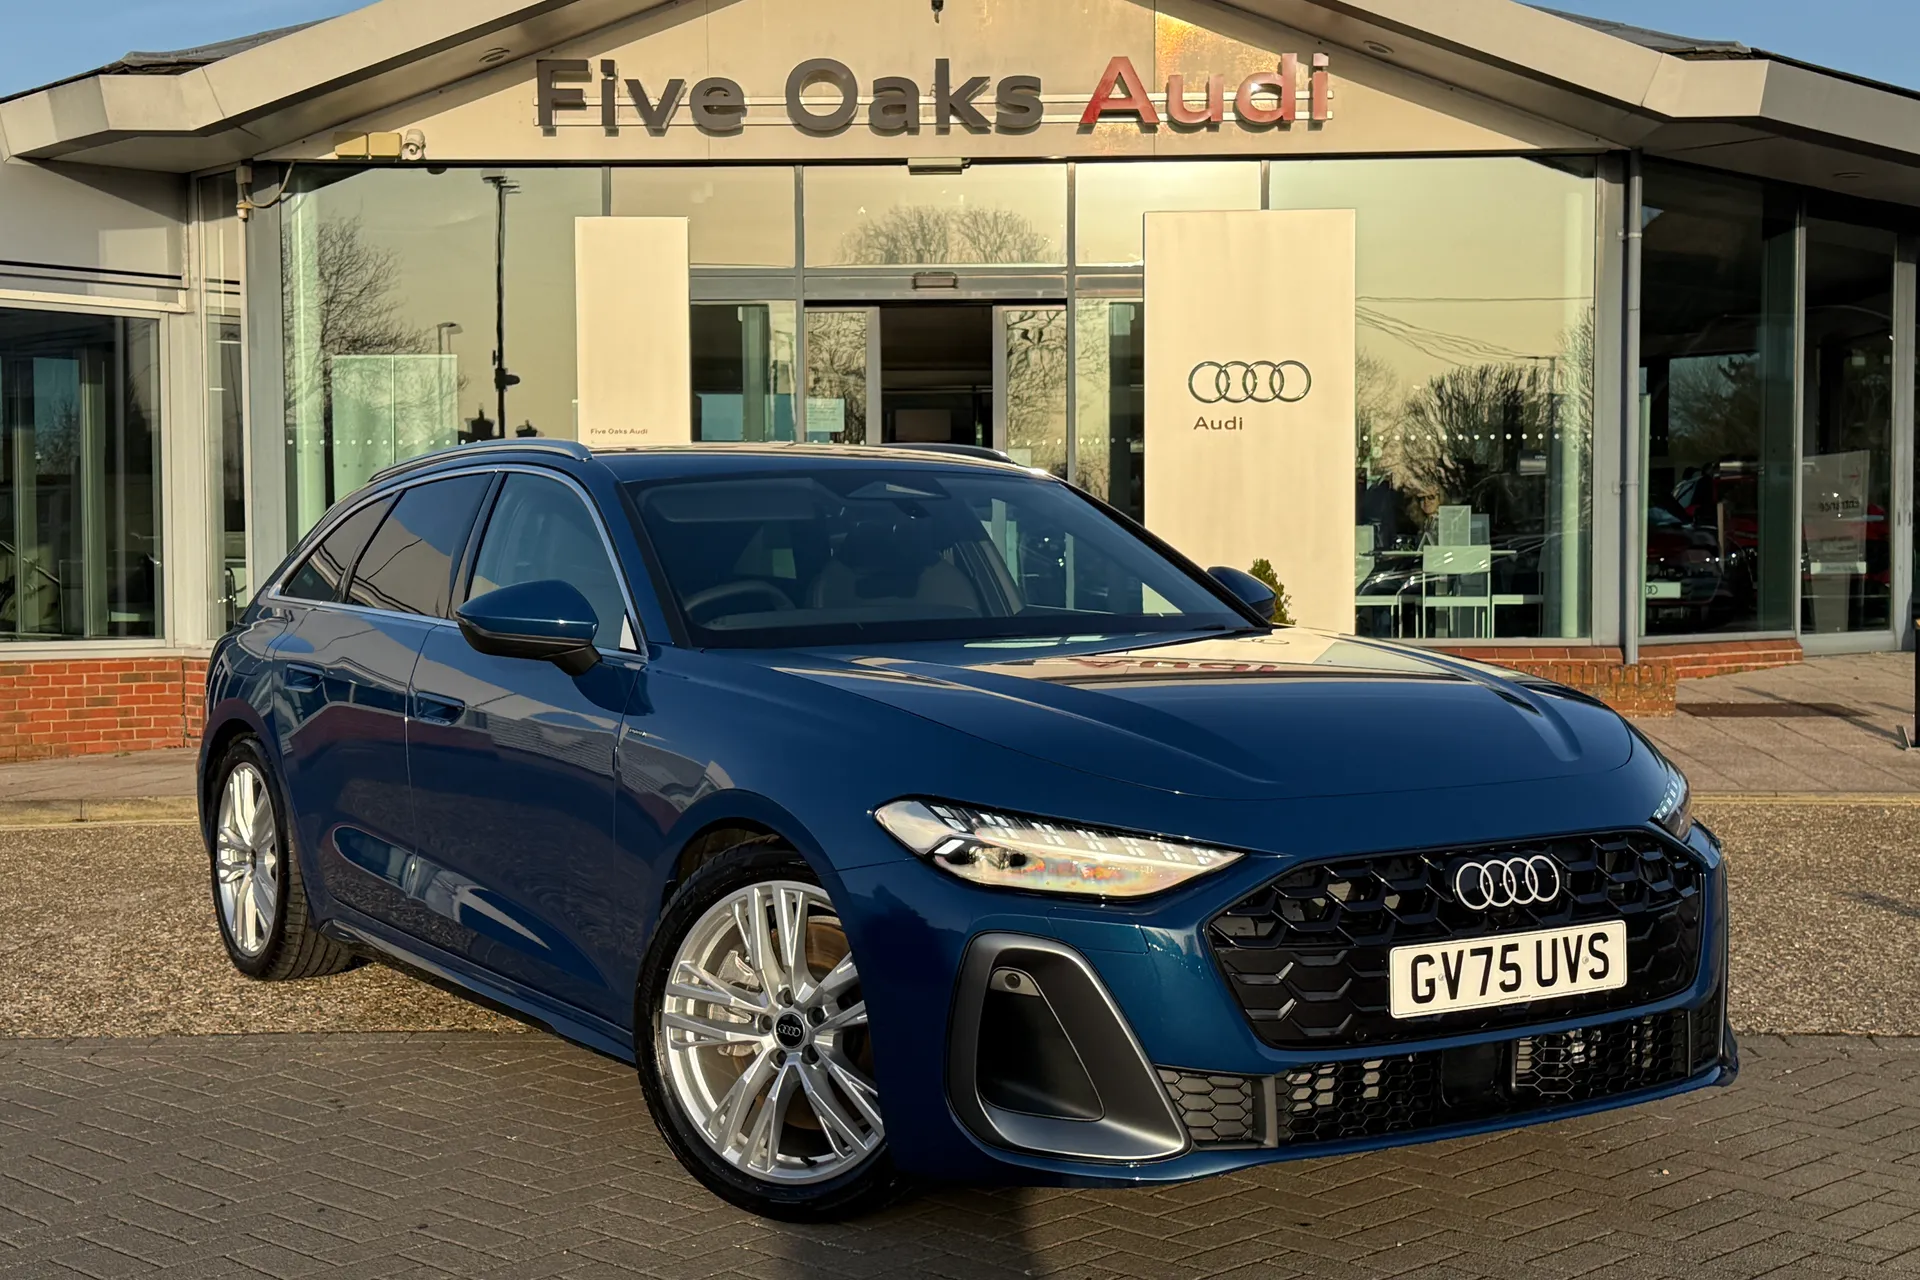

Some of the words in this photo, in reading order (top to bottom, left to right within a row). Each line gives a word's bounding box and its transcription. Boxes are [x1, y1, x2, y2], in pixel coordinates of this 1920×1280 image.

[536, 59, 746, 131] Five
[785, 58, 1044, 131] Oaks
[1079, 52, 1330, 125] Audi
[1193, 416, 1243, 430] Audi
[1410, 943, 1522, 1005] GV75
[1535, 931, 1611, 988] UVS
